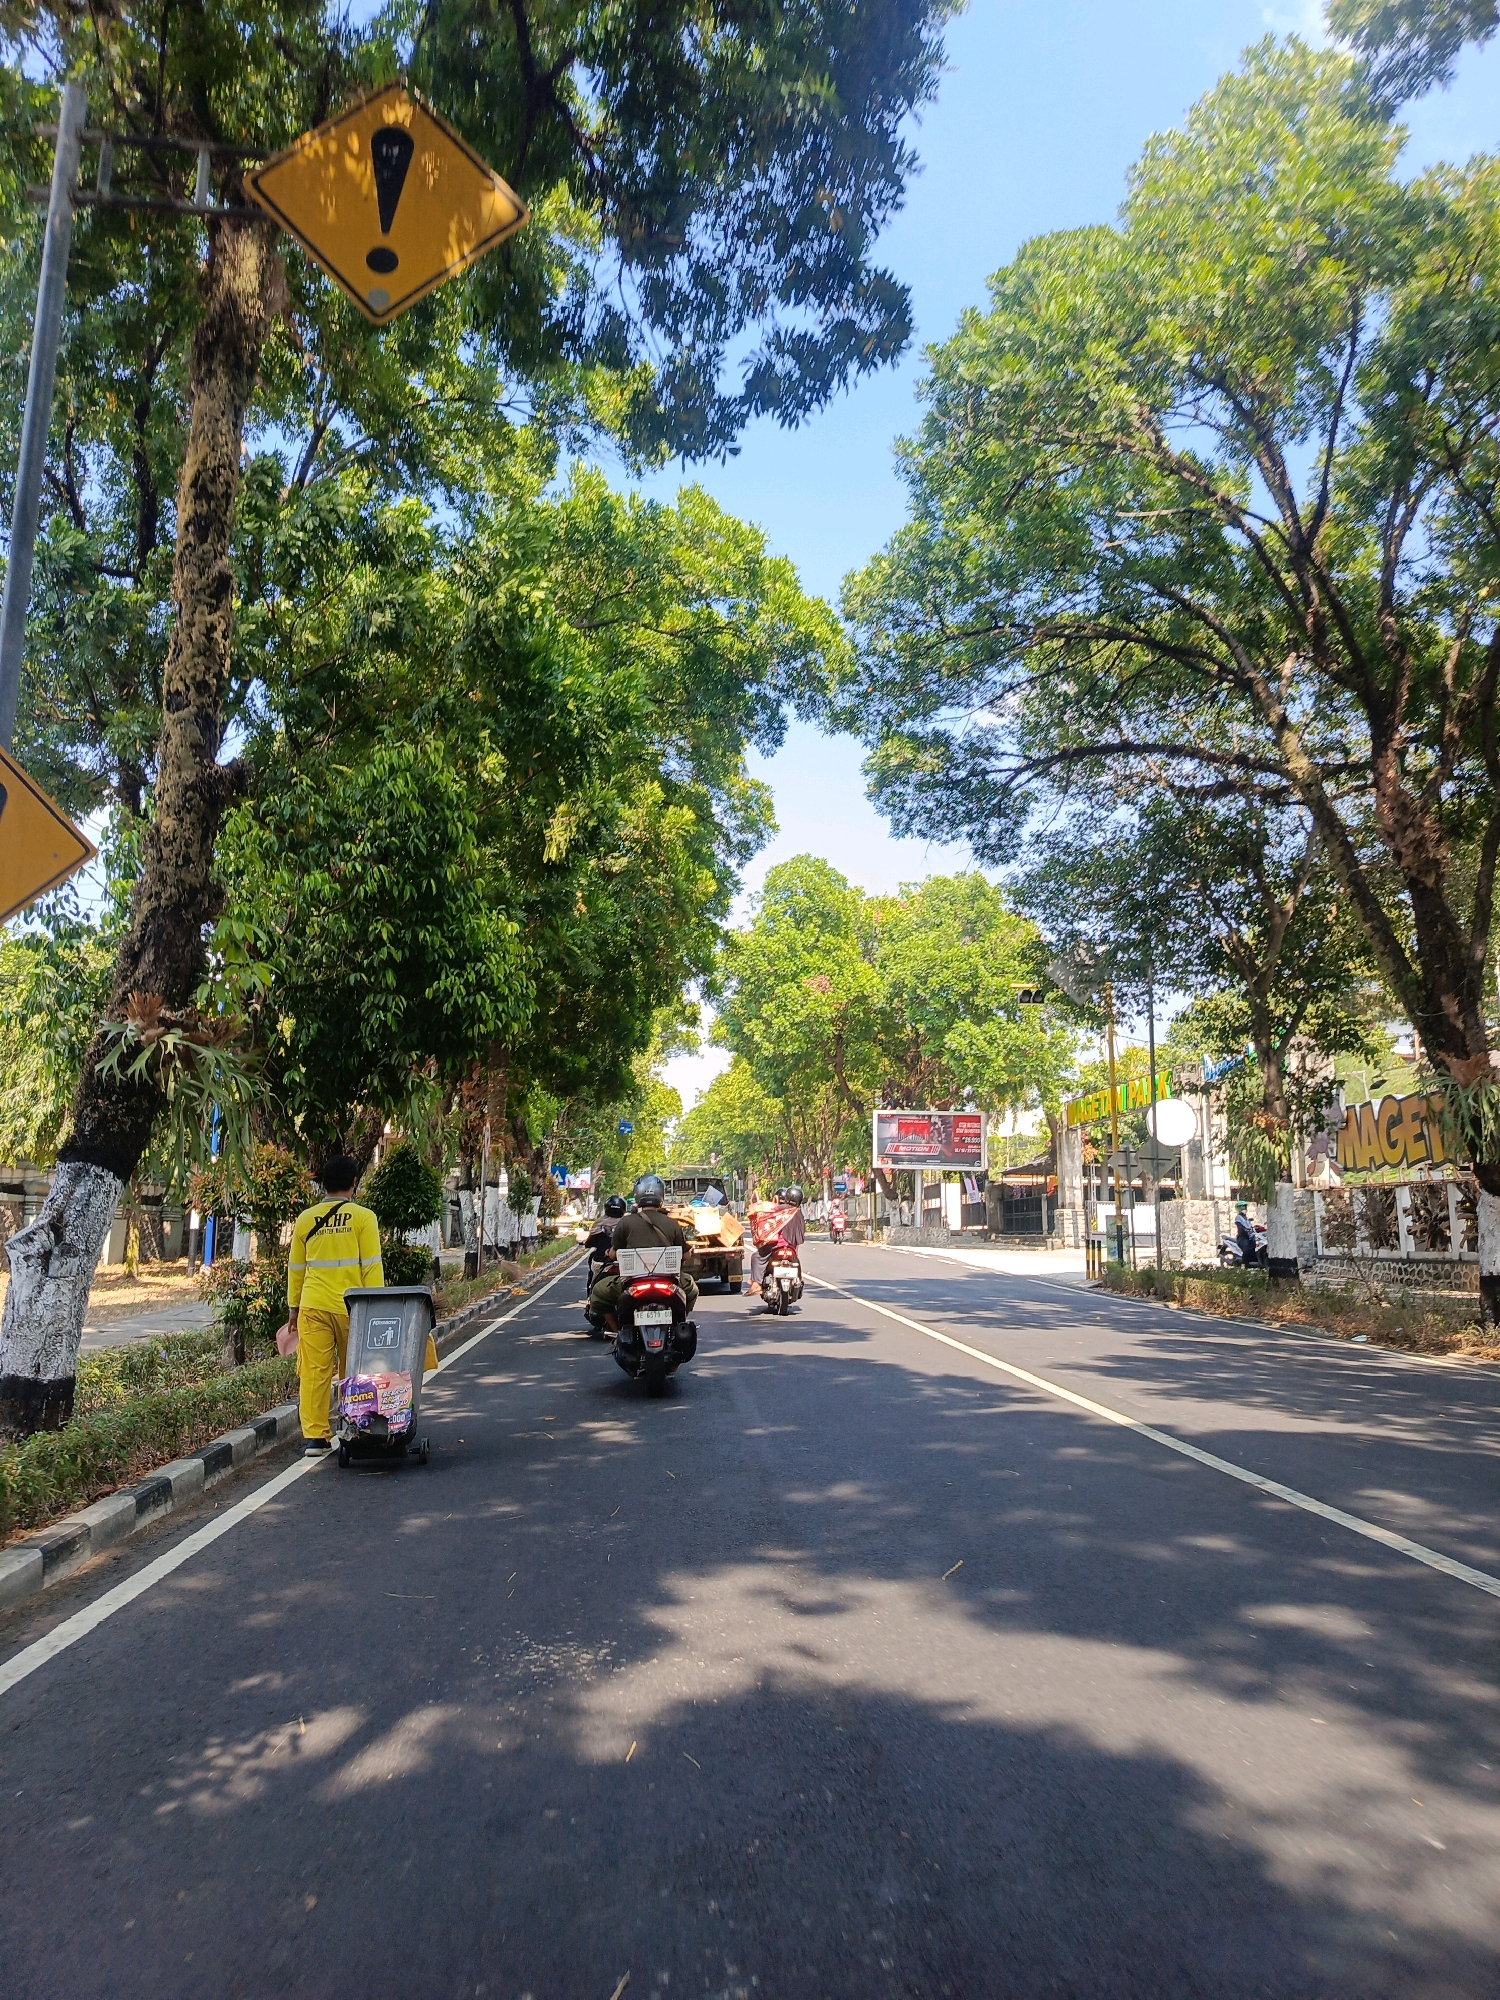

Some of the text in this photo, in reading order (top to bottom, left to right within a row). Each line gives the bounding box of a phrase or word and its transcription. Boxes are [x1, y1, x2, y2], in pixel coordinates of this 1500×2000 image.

[1068, 1084, 1127, 1127] MAGETAN
[1335, 1091, 1457, 1174] MAGET
[344, 1391, 374, 1405] Aroma
